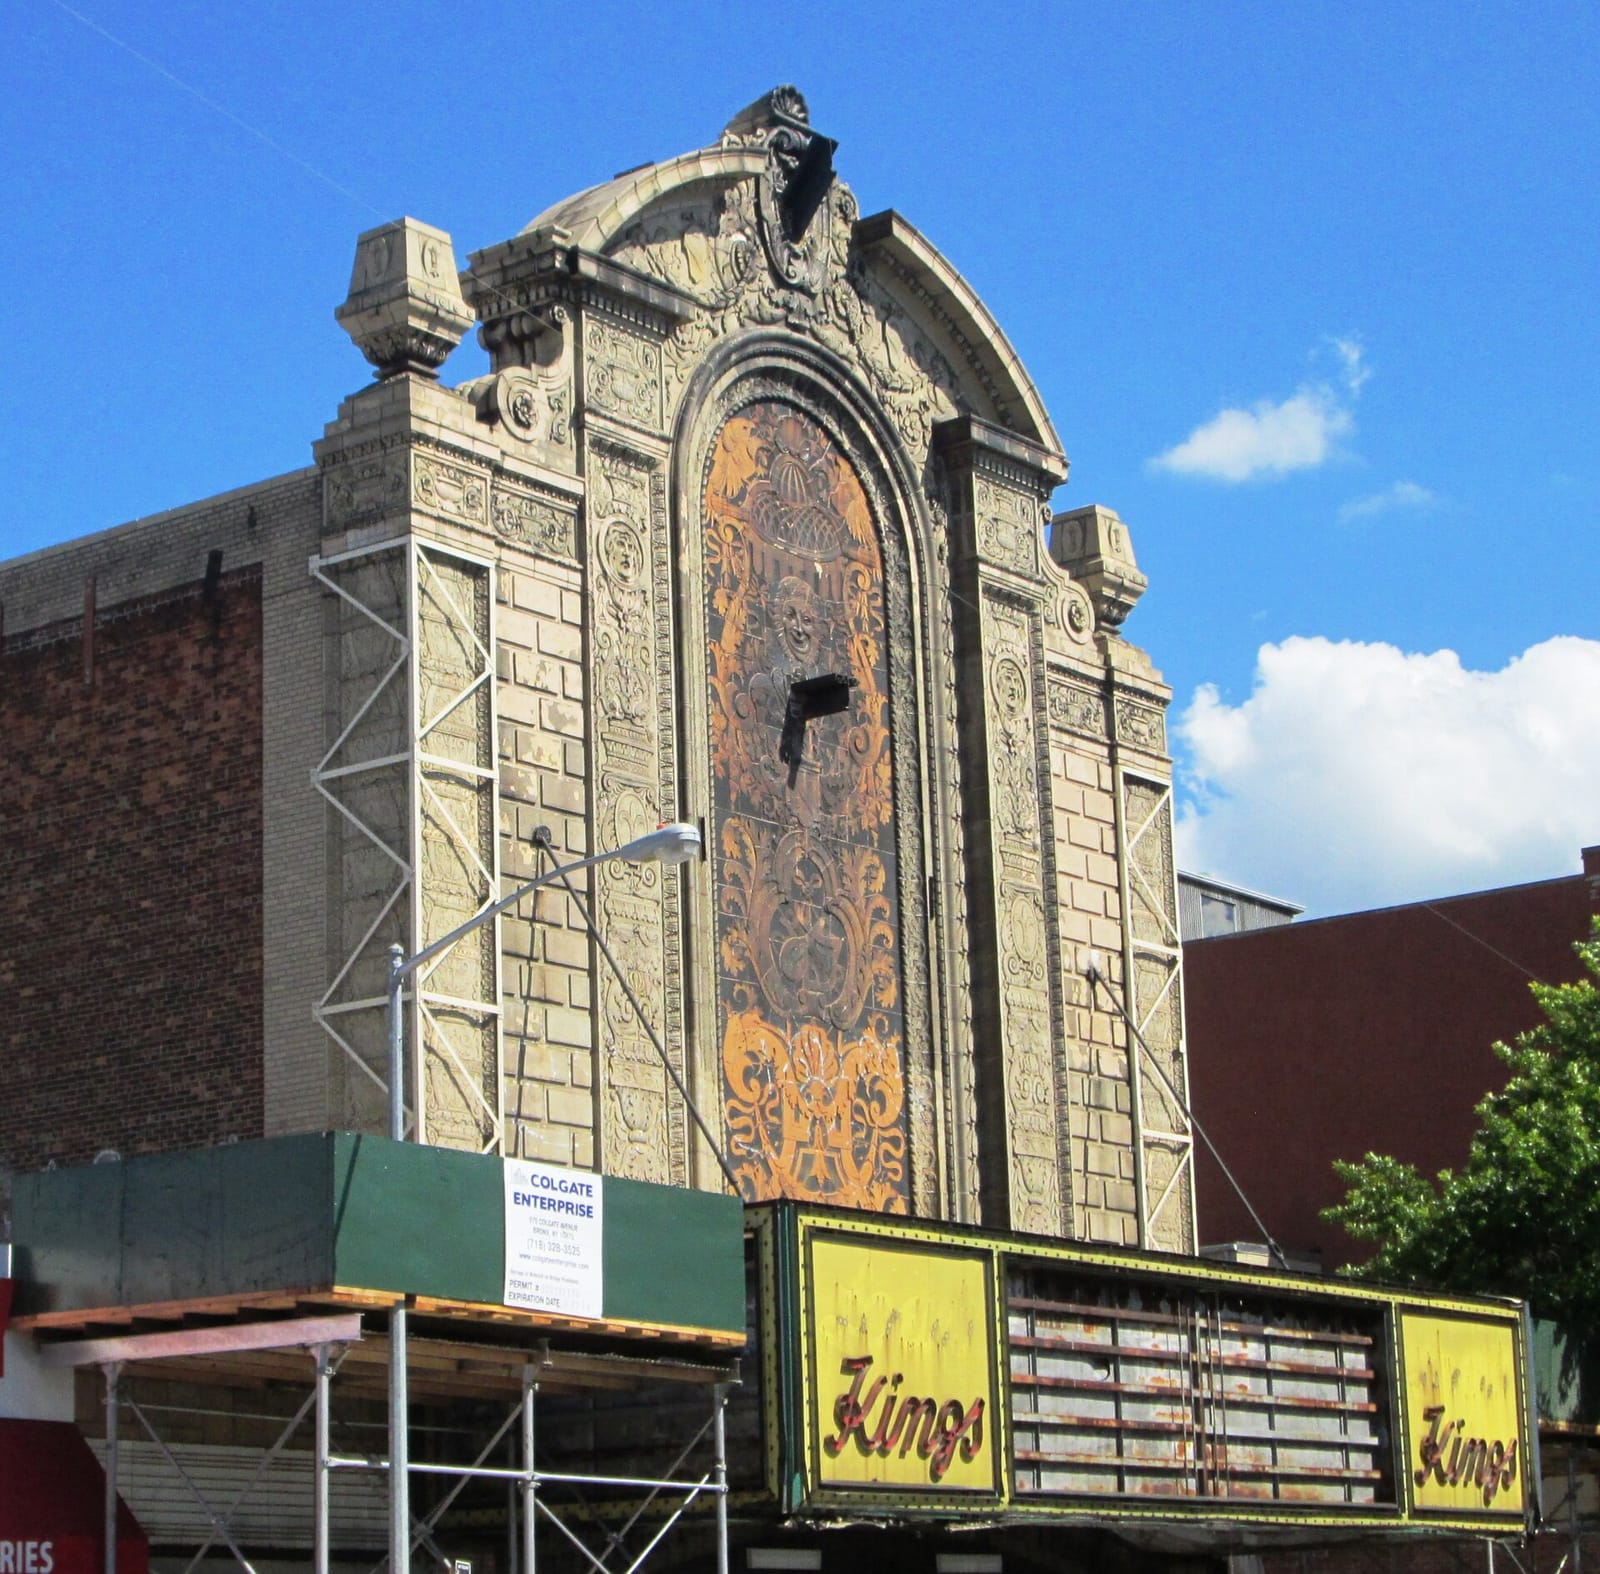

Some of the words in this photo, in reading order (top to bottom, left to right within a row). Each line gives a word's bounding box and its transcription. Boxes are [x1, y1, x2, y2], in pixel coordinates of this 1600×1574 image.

[530, 1173, 594, 1198] COLGATE
[513, 1191, 595, 1219] ENTERPRISE
[509, 1279, 533, 1291] PERMIT
[508, 1291, 545, 1305] EXPIRATION
[545, 1297, 561, 1309] DATE
[823, 1355, 985, 1483] Kings
[1414, 1405, 1518, 1509] Kings
